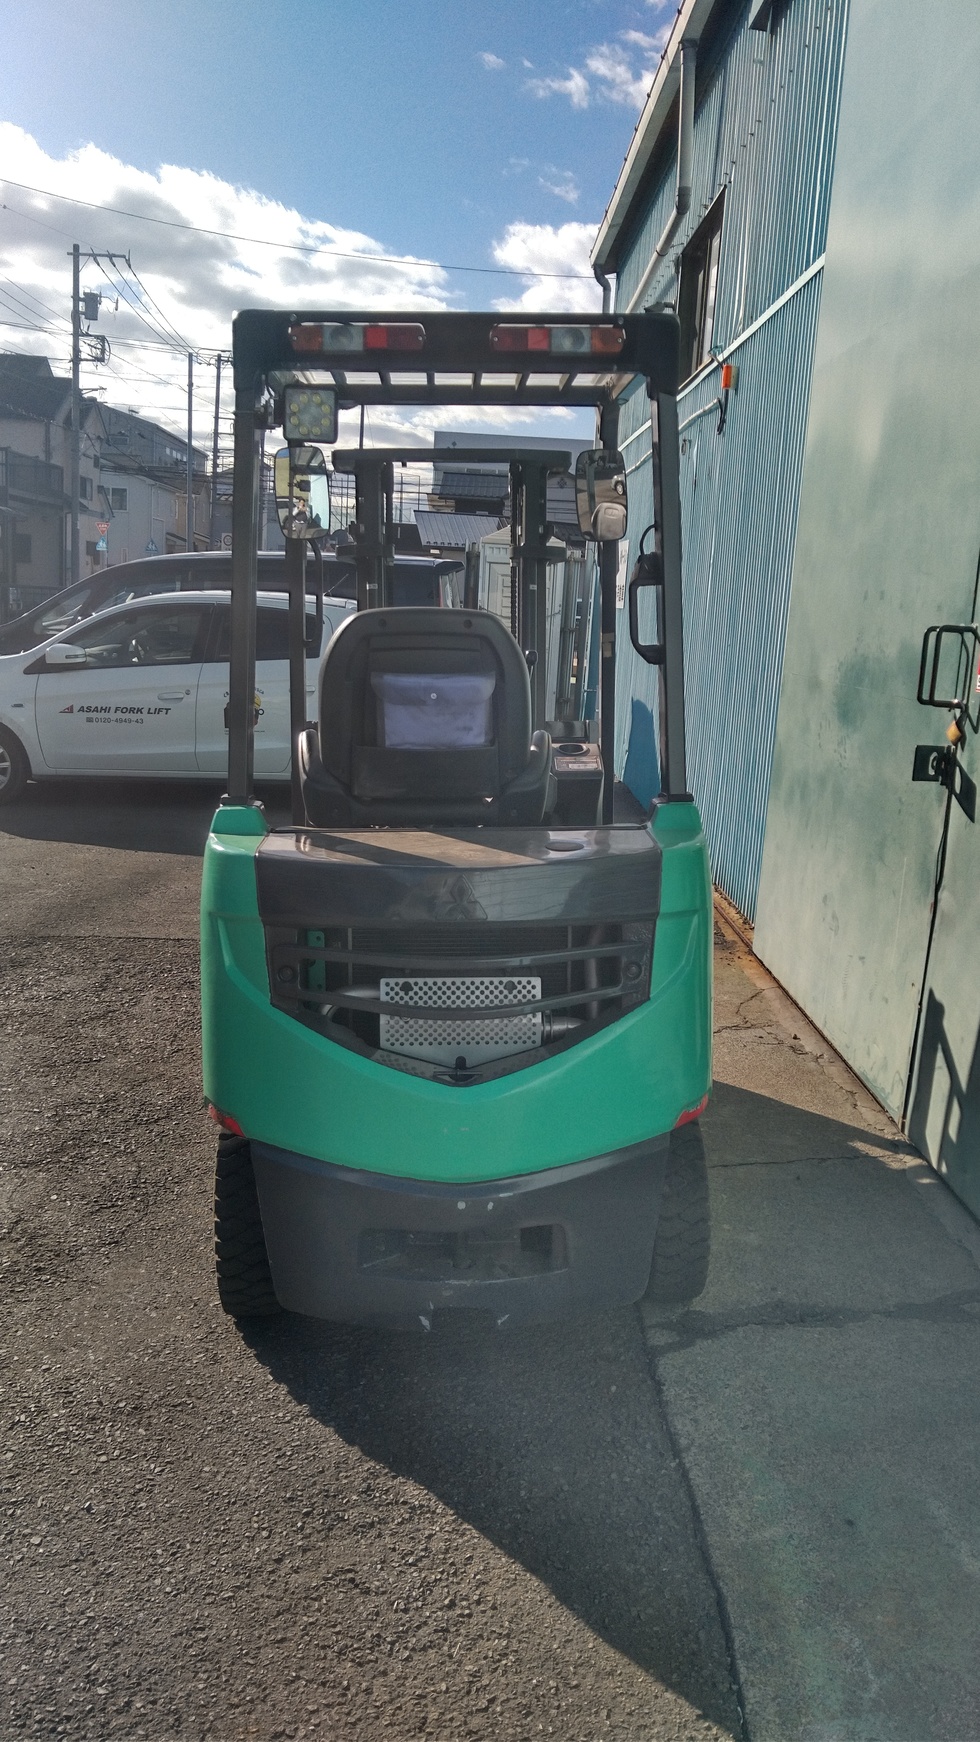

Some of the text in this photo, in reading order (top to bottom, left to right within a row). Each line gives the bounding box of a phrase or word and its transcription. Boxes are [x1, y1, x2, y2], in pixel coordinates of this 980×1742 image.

[77, 705, 171, 715] ASAHI FORK LIFT
